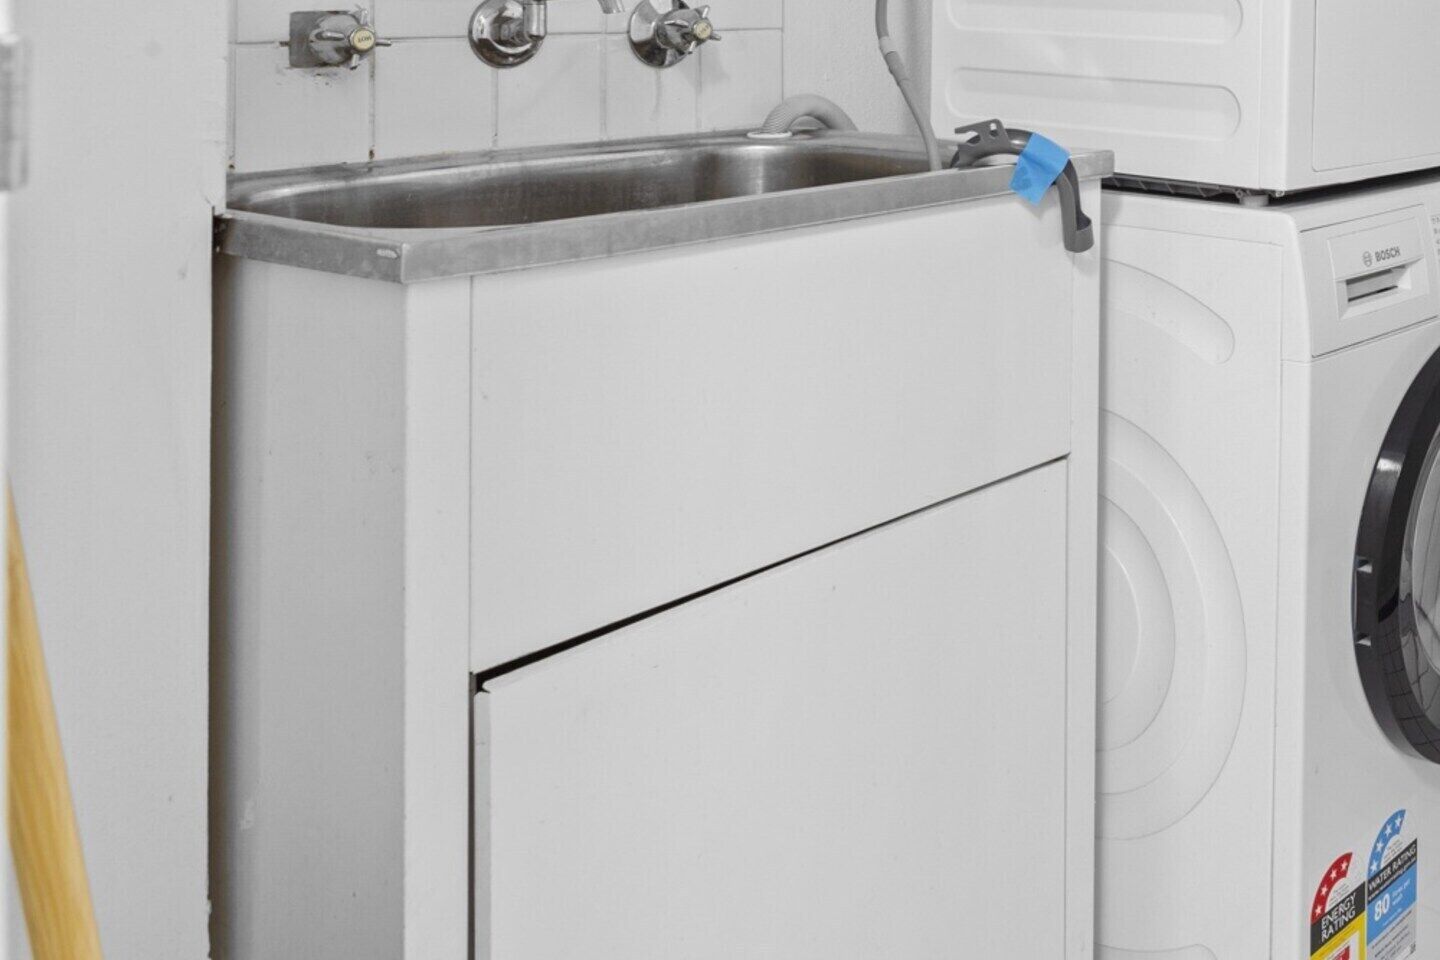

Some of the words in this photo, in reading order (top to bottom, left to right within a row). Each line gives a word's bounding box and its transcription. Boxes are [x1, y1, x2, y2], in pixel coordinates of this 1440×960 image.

[1375, 246, 1401, 262] BOSCH
[1369, 867, 1391, 891] WATER
[1392, 843, 1416, 872] RATING
[1321, 892, 1356, 929] ENERGY
[1374, 893, 1391, 922] 80
[1321, 908, 1356, 943] RATING
